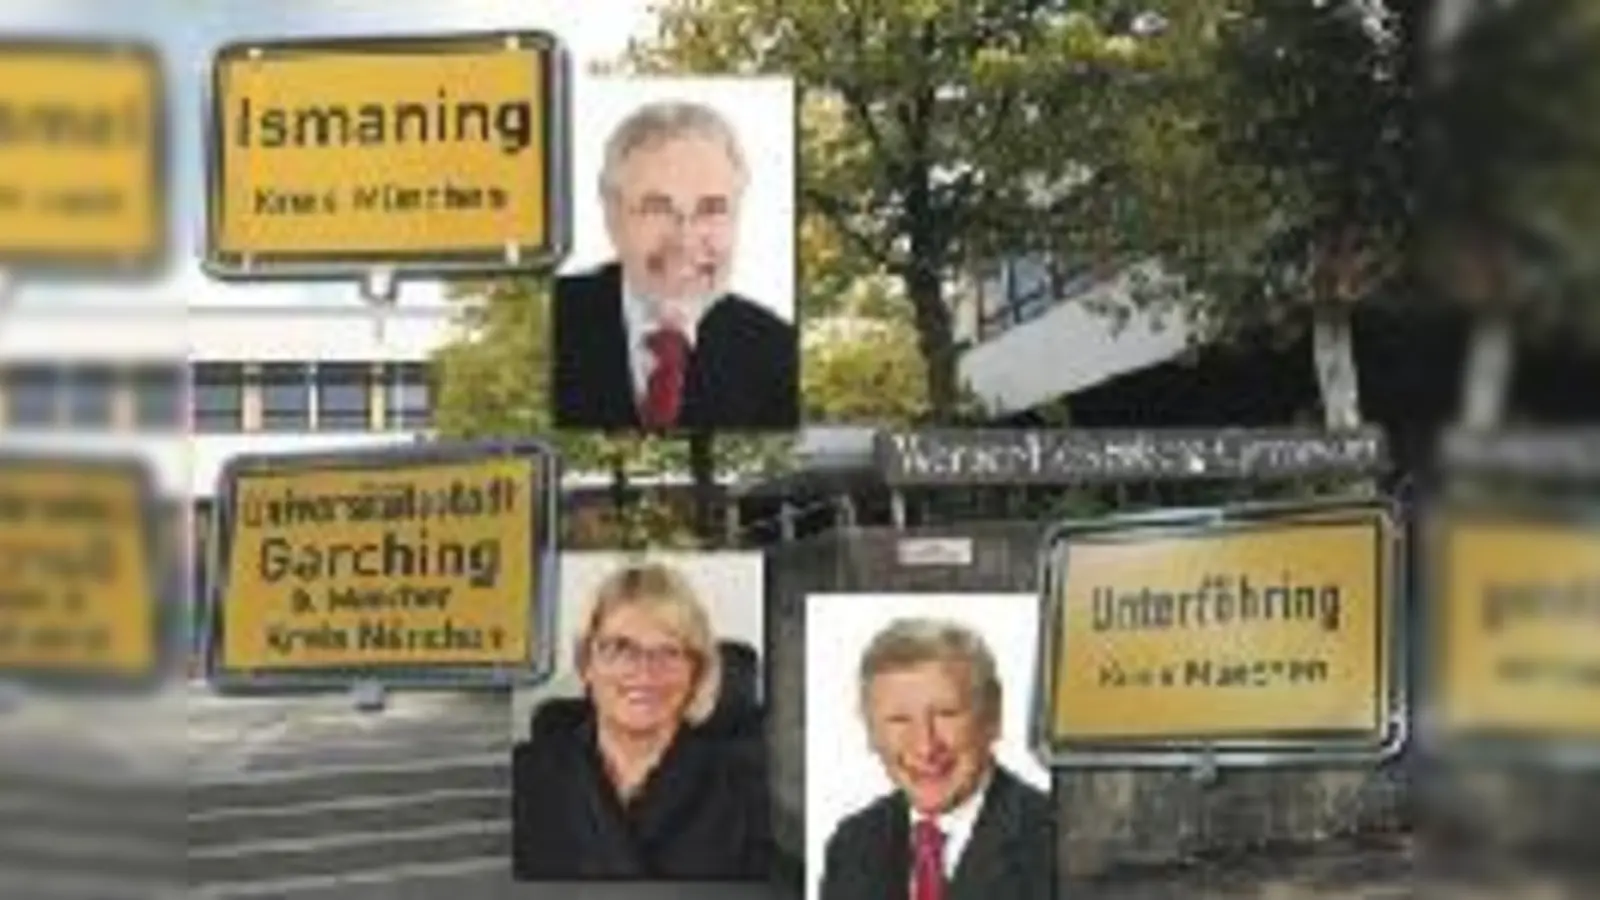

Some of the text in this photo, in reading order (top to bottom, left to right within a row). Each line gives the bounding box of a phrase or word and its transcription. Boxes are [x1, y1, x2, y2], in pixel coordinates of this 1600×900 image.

[237, 88, 532, 154] Ismaning
[261, 531, 500, 588] Garching
[1092, 571, 1342, 632] Unterföhring
